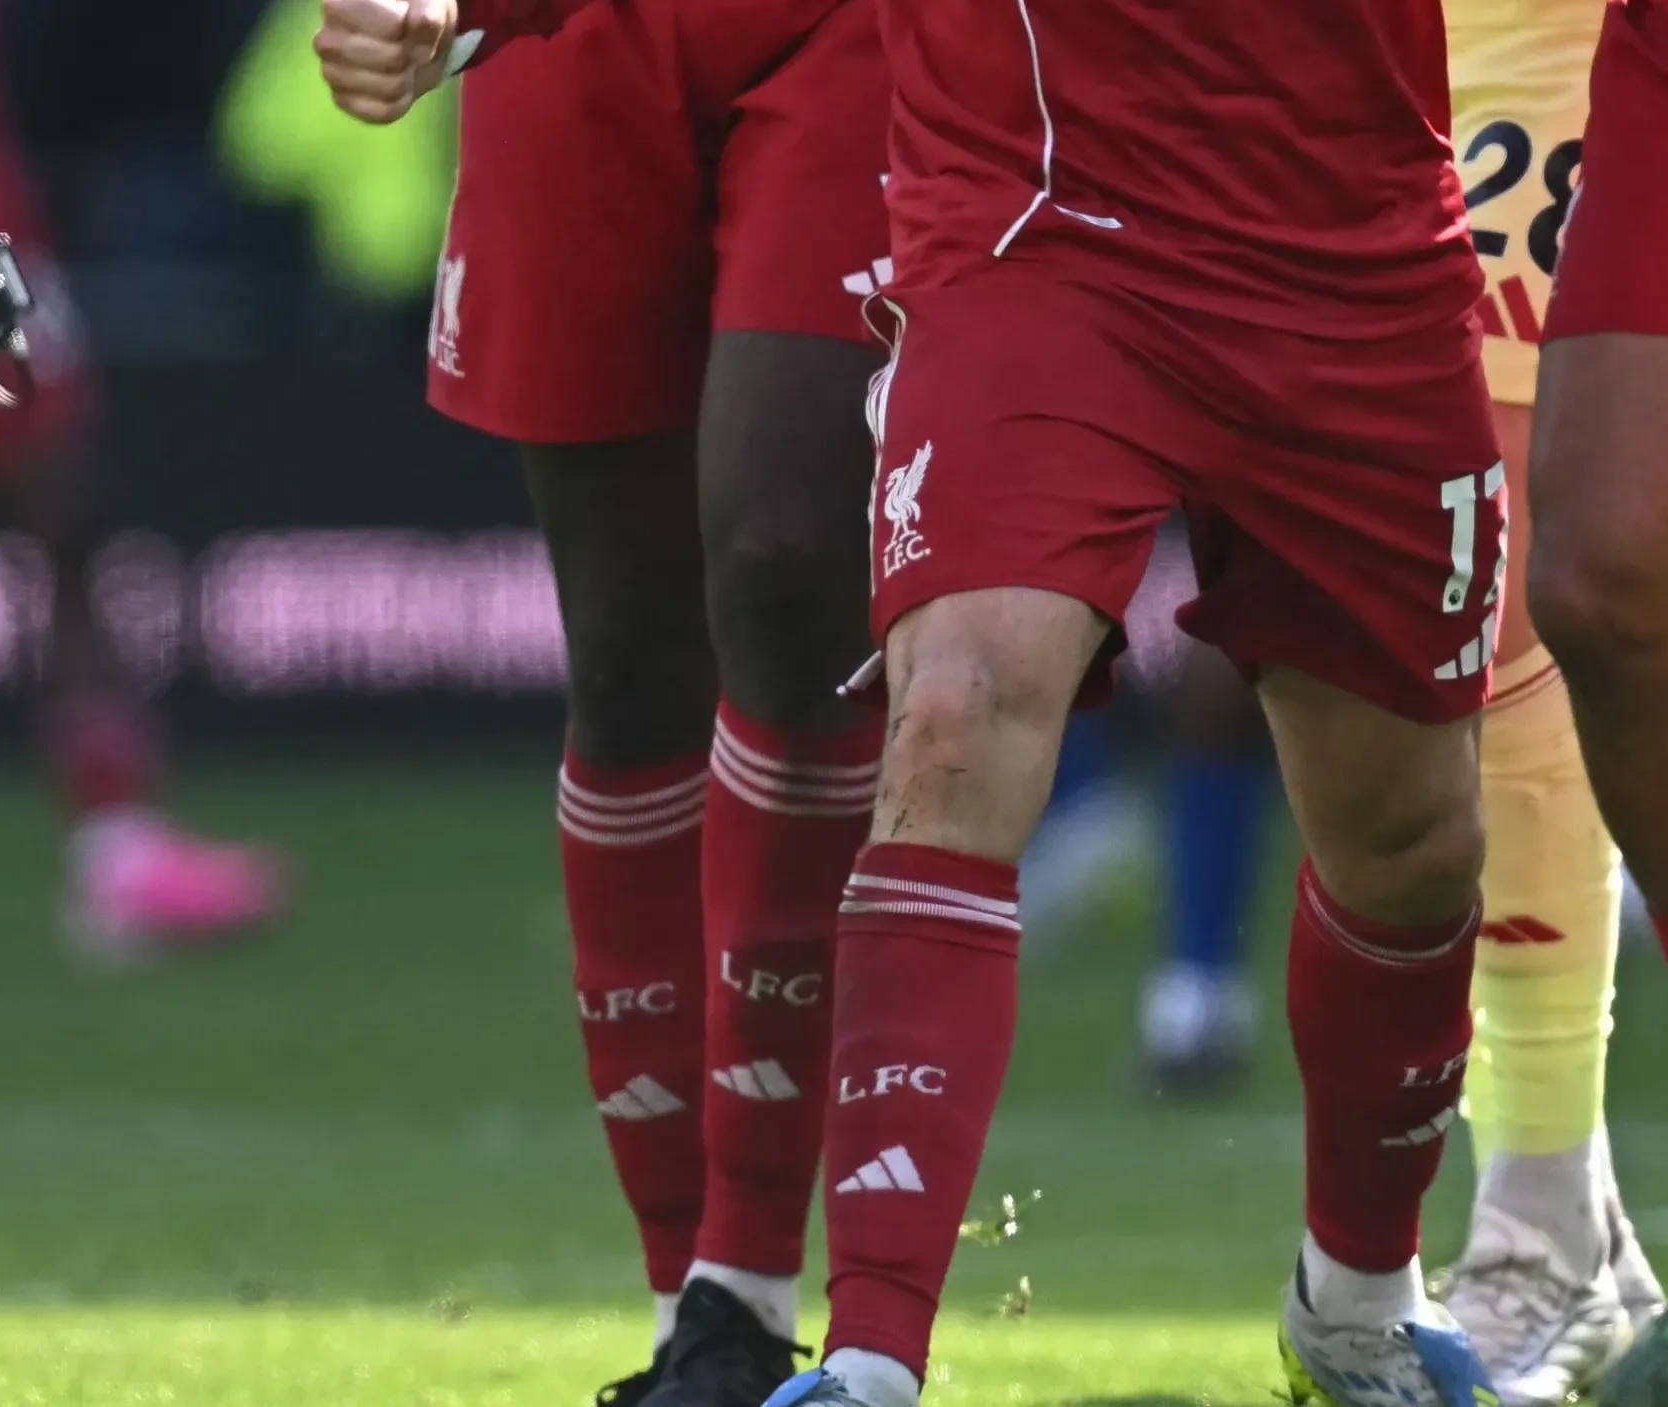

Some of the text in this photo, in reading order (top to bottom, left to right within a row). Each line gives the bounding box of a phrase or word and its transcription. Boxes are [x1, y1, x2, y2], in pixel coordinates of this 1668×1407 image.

[720, 949, 823, 1007] LFC
[578, 980, 677, 1022] LFC
[838, 1063, 947, 1105] LFC
